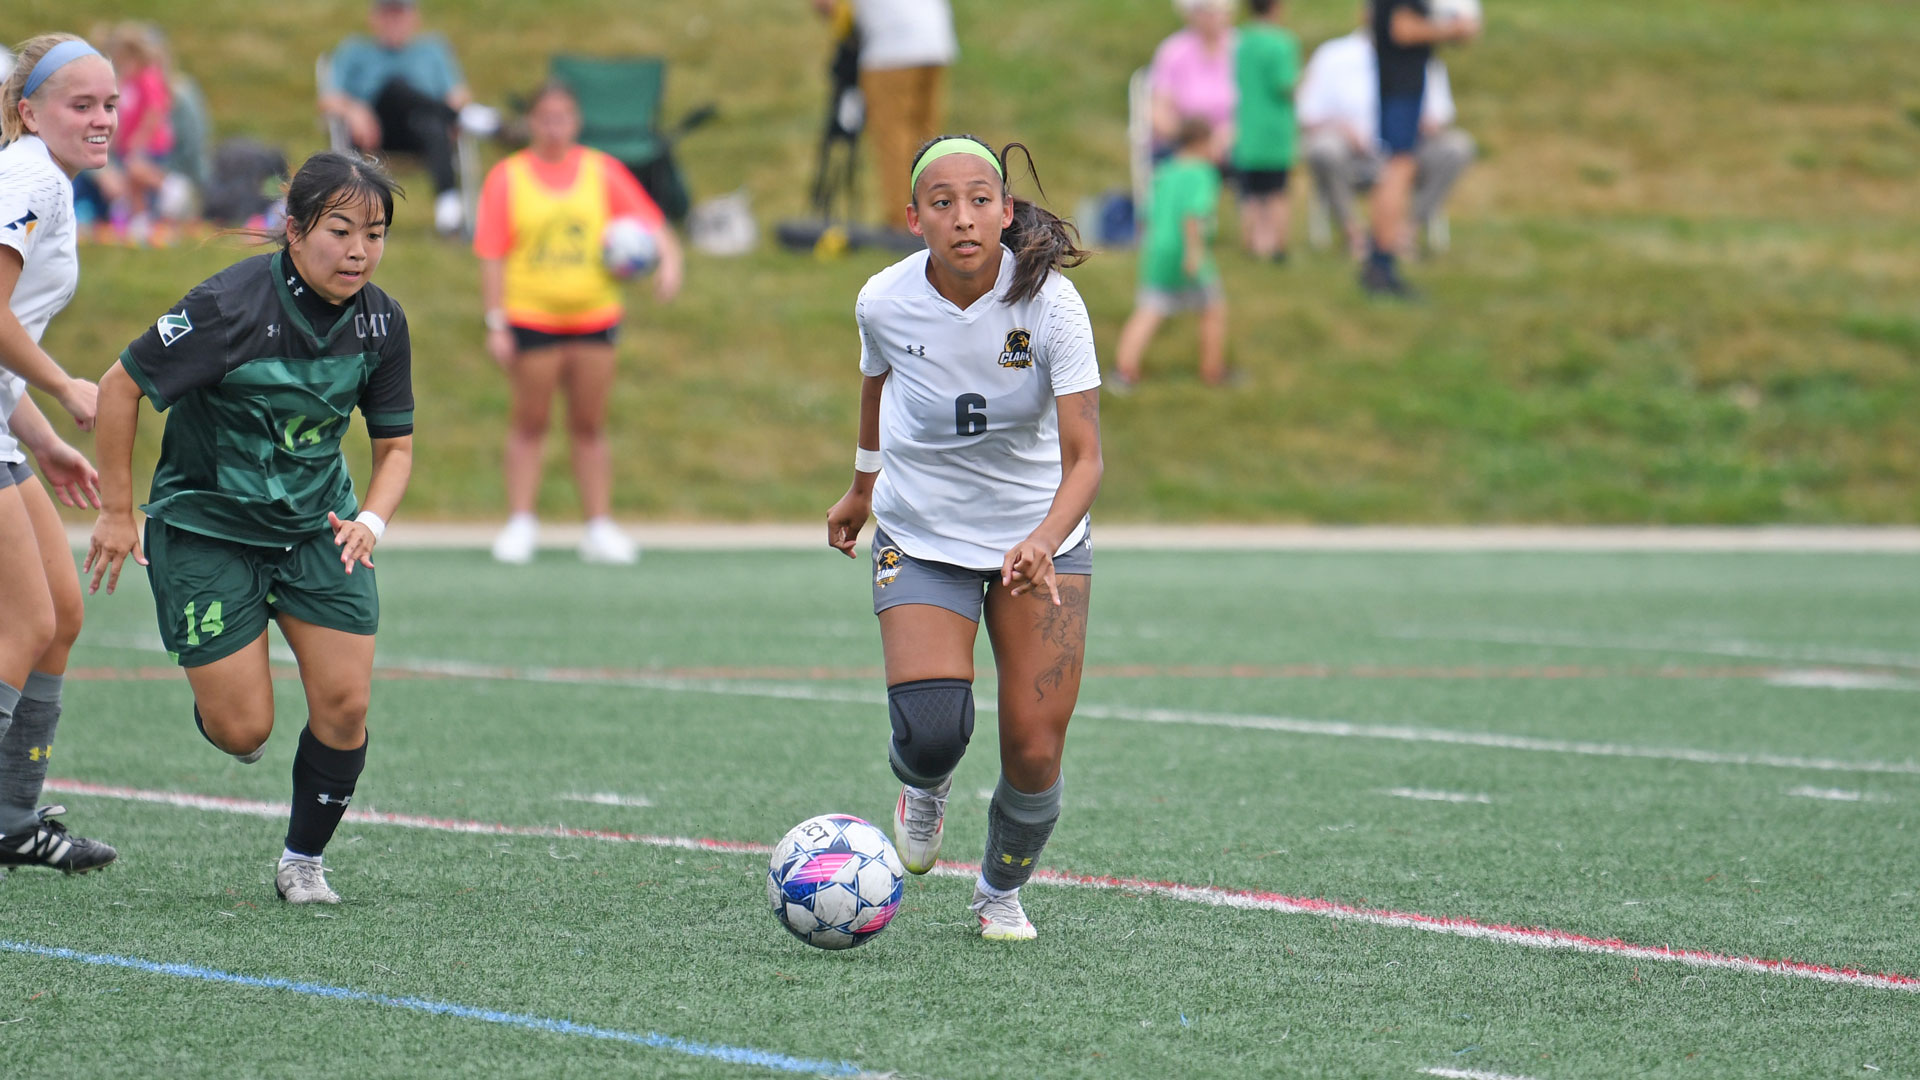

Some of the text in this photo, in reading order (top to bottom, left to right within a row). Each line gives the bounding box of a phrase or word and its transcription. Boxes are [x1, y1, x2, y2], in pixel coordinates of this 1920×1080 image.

[955, 392, 987, 436] 6
[183, 600, 224, 645] 14
[797, 821, 830, 843] ECT
